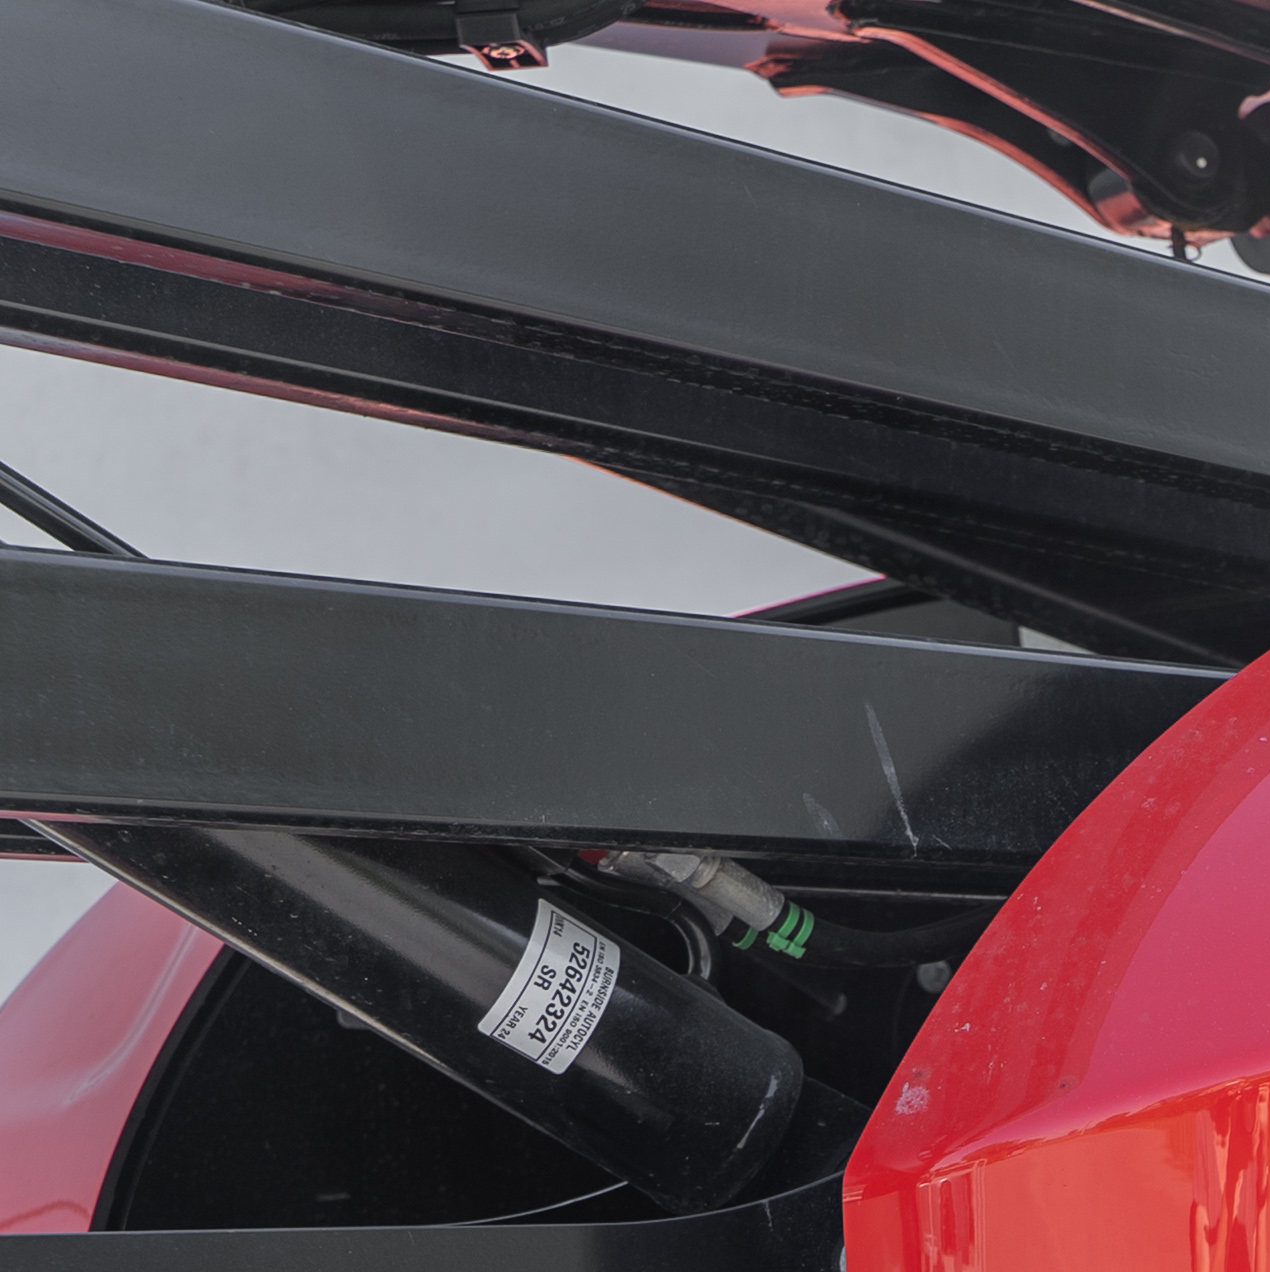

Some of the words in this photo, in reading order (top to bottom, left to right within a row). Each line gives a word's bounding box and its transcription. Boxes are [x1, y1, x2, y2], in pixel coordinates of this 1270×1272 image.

[528, 942, 590, 1044] 52642324
[533, 965, 557, 991] SR
[591, 966, 614, 1011] BURNSIDE
[506, 1006, 528, 1029] YEAR
[578, 999, 589, 1013] EN
[565, 1010, 597, 1051] AUTOCYL
